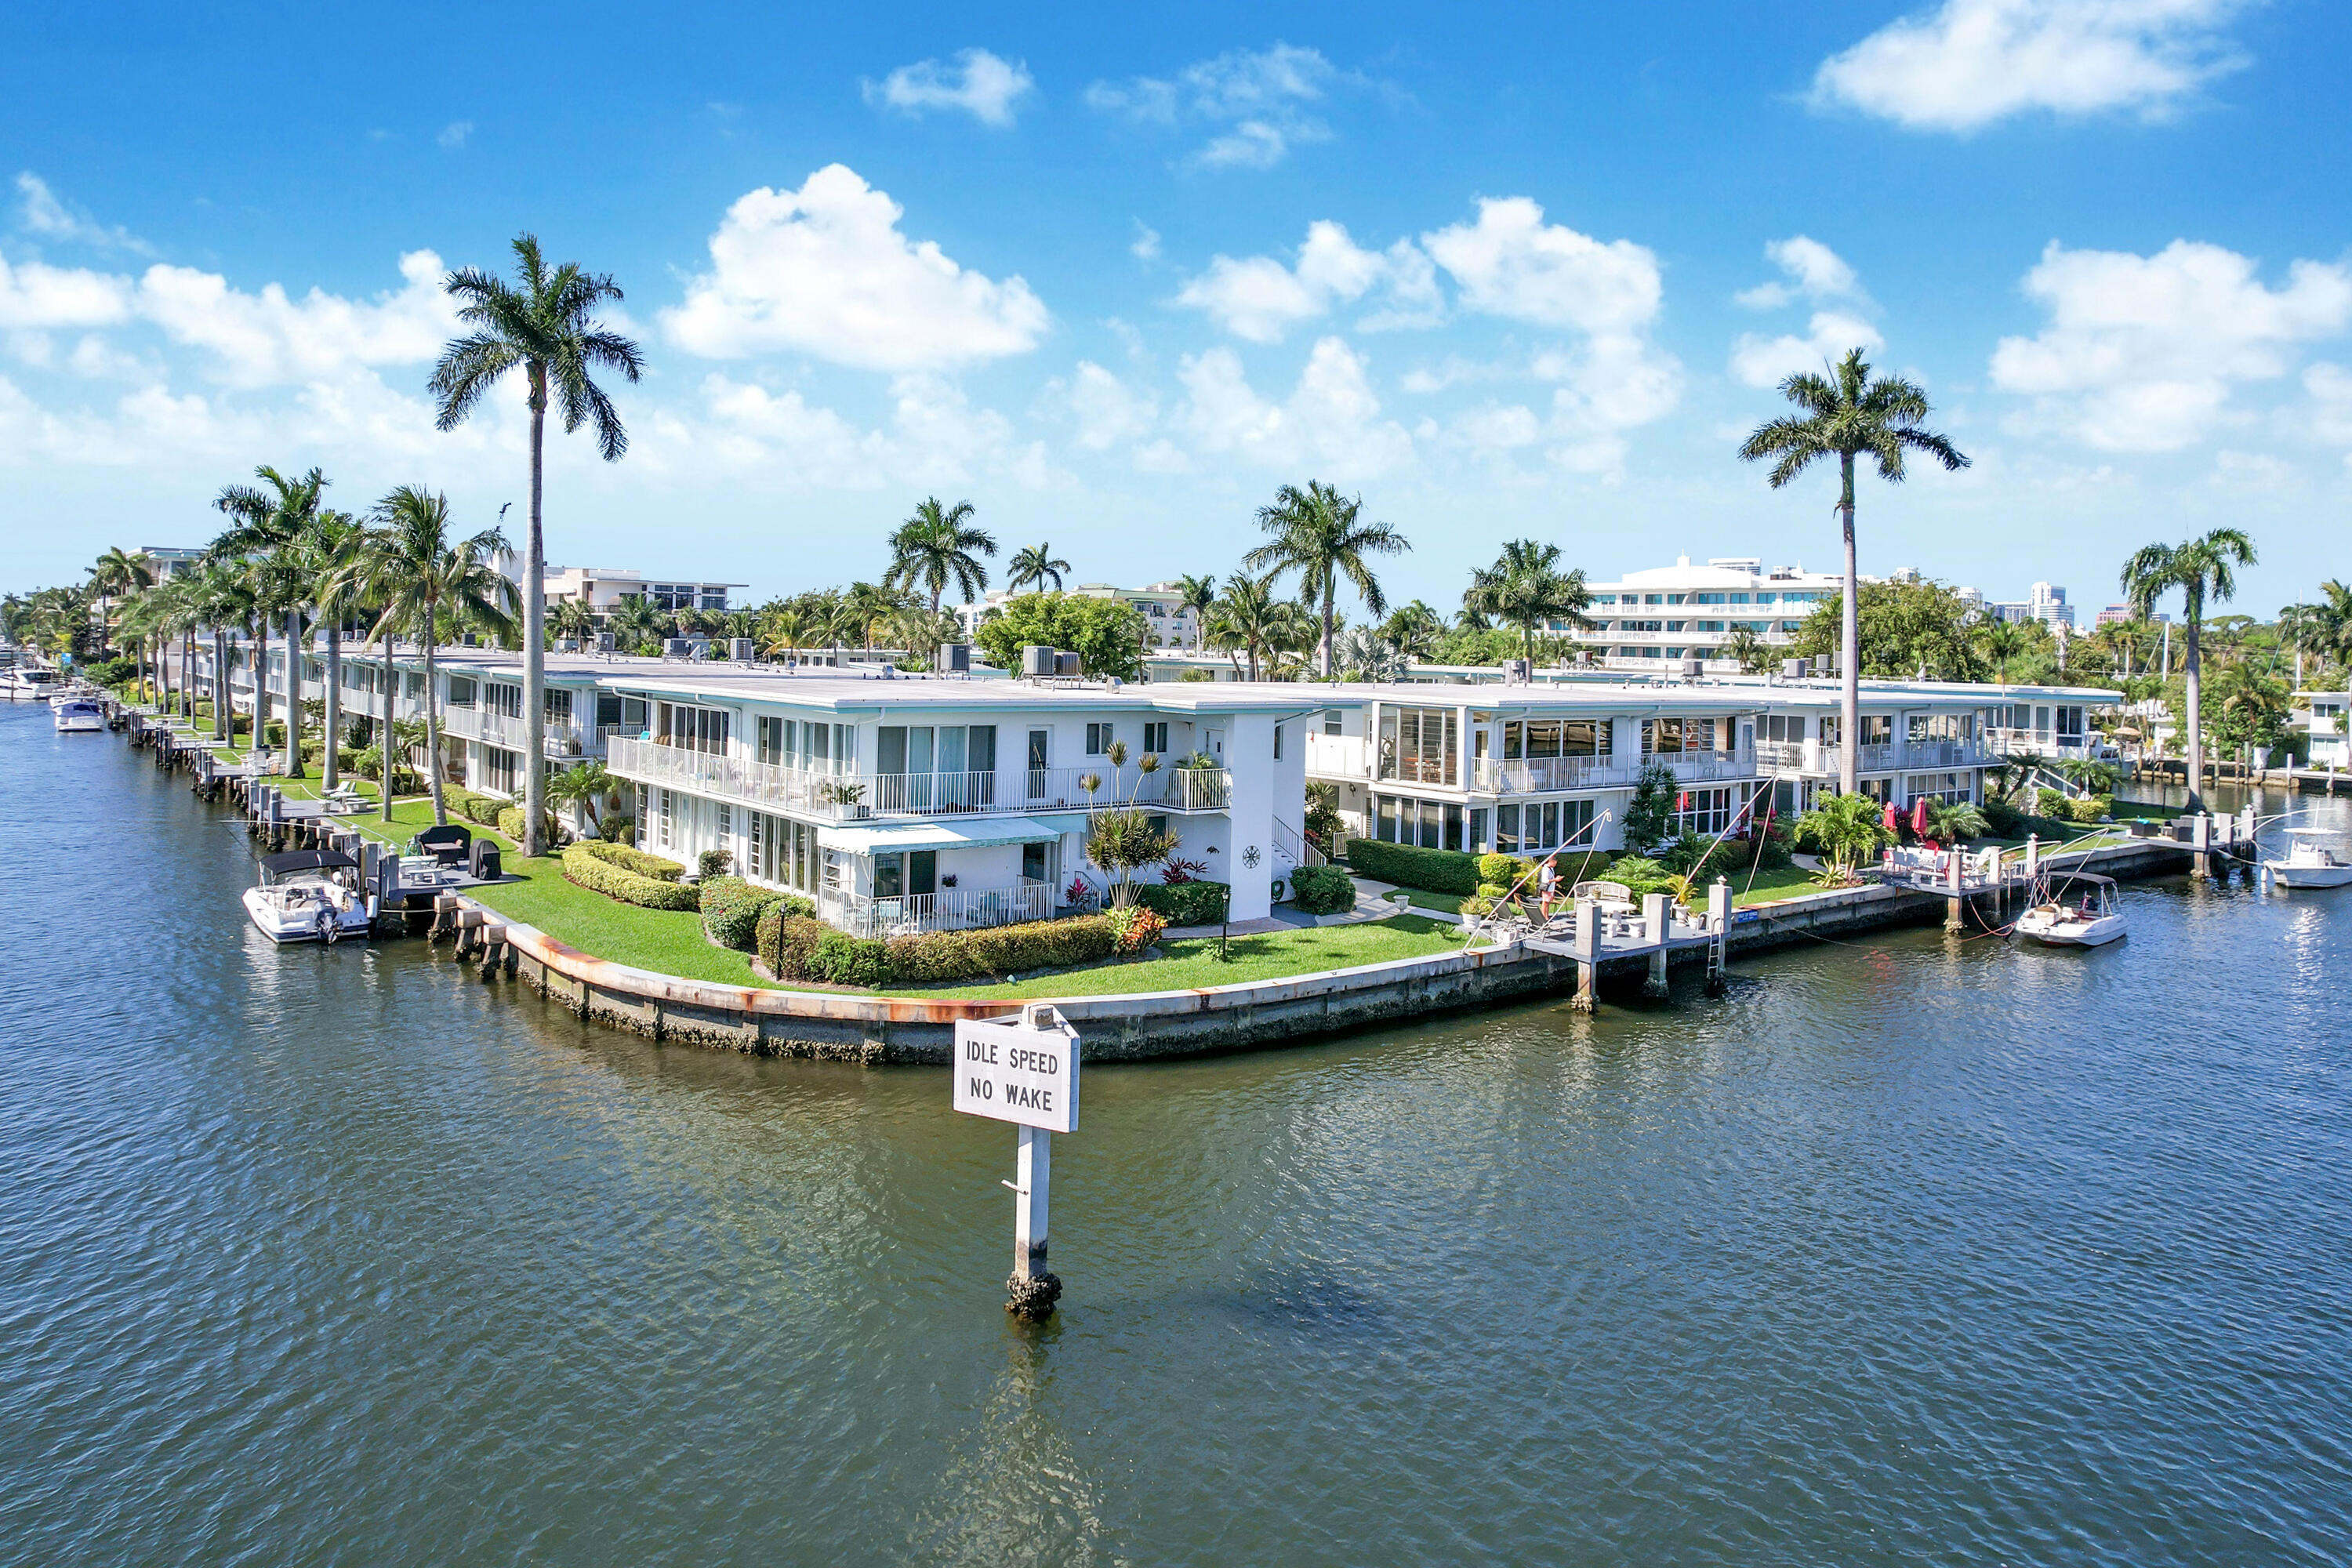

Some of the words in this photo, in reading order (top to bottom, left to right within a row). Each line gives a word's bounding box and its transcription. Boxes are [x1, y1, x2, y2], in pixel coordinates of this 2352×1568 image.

[967, 1040, 998, 1065] IDLE
[1009, 1048, 1058, 1075] SPEED
[971, 1077, 993, 1100] NO
[1006, 1083, 1052, 1112] WAKE
